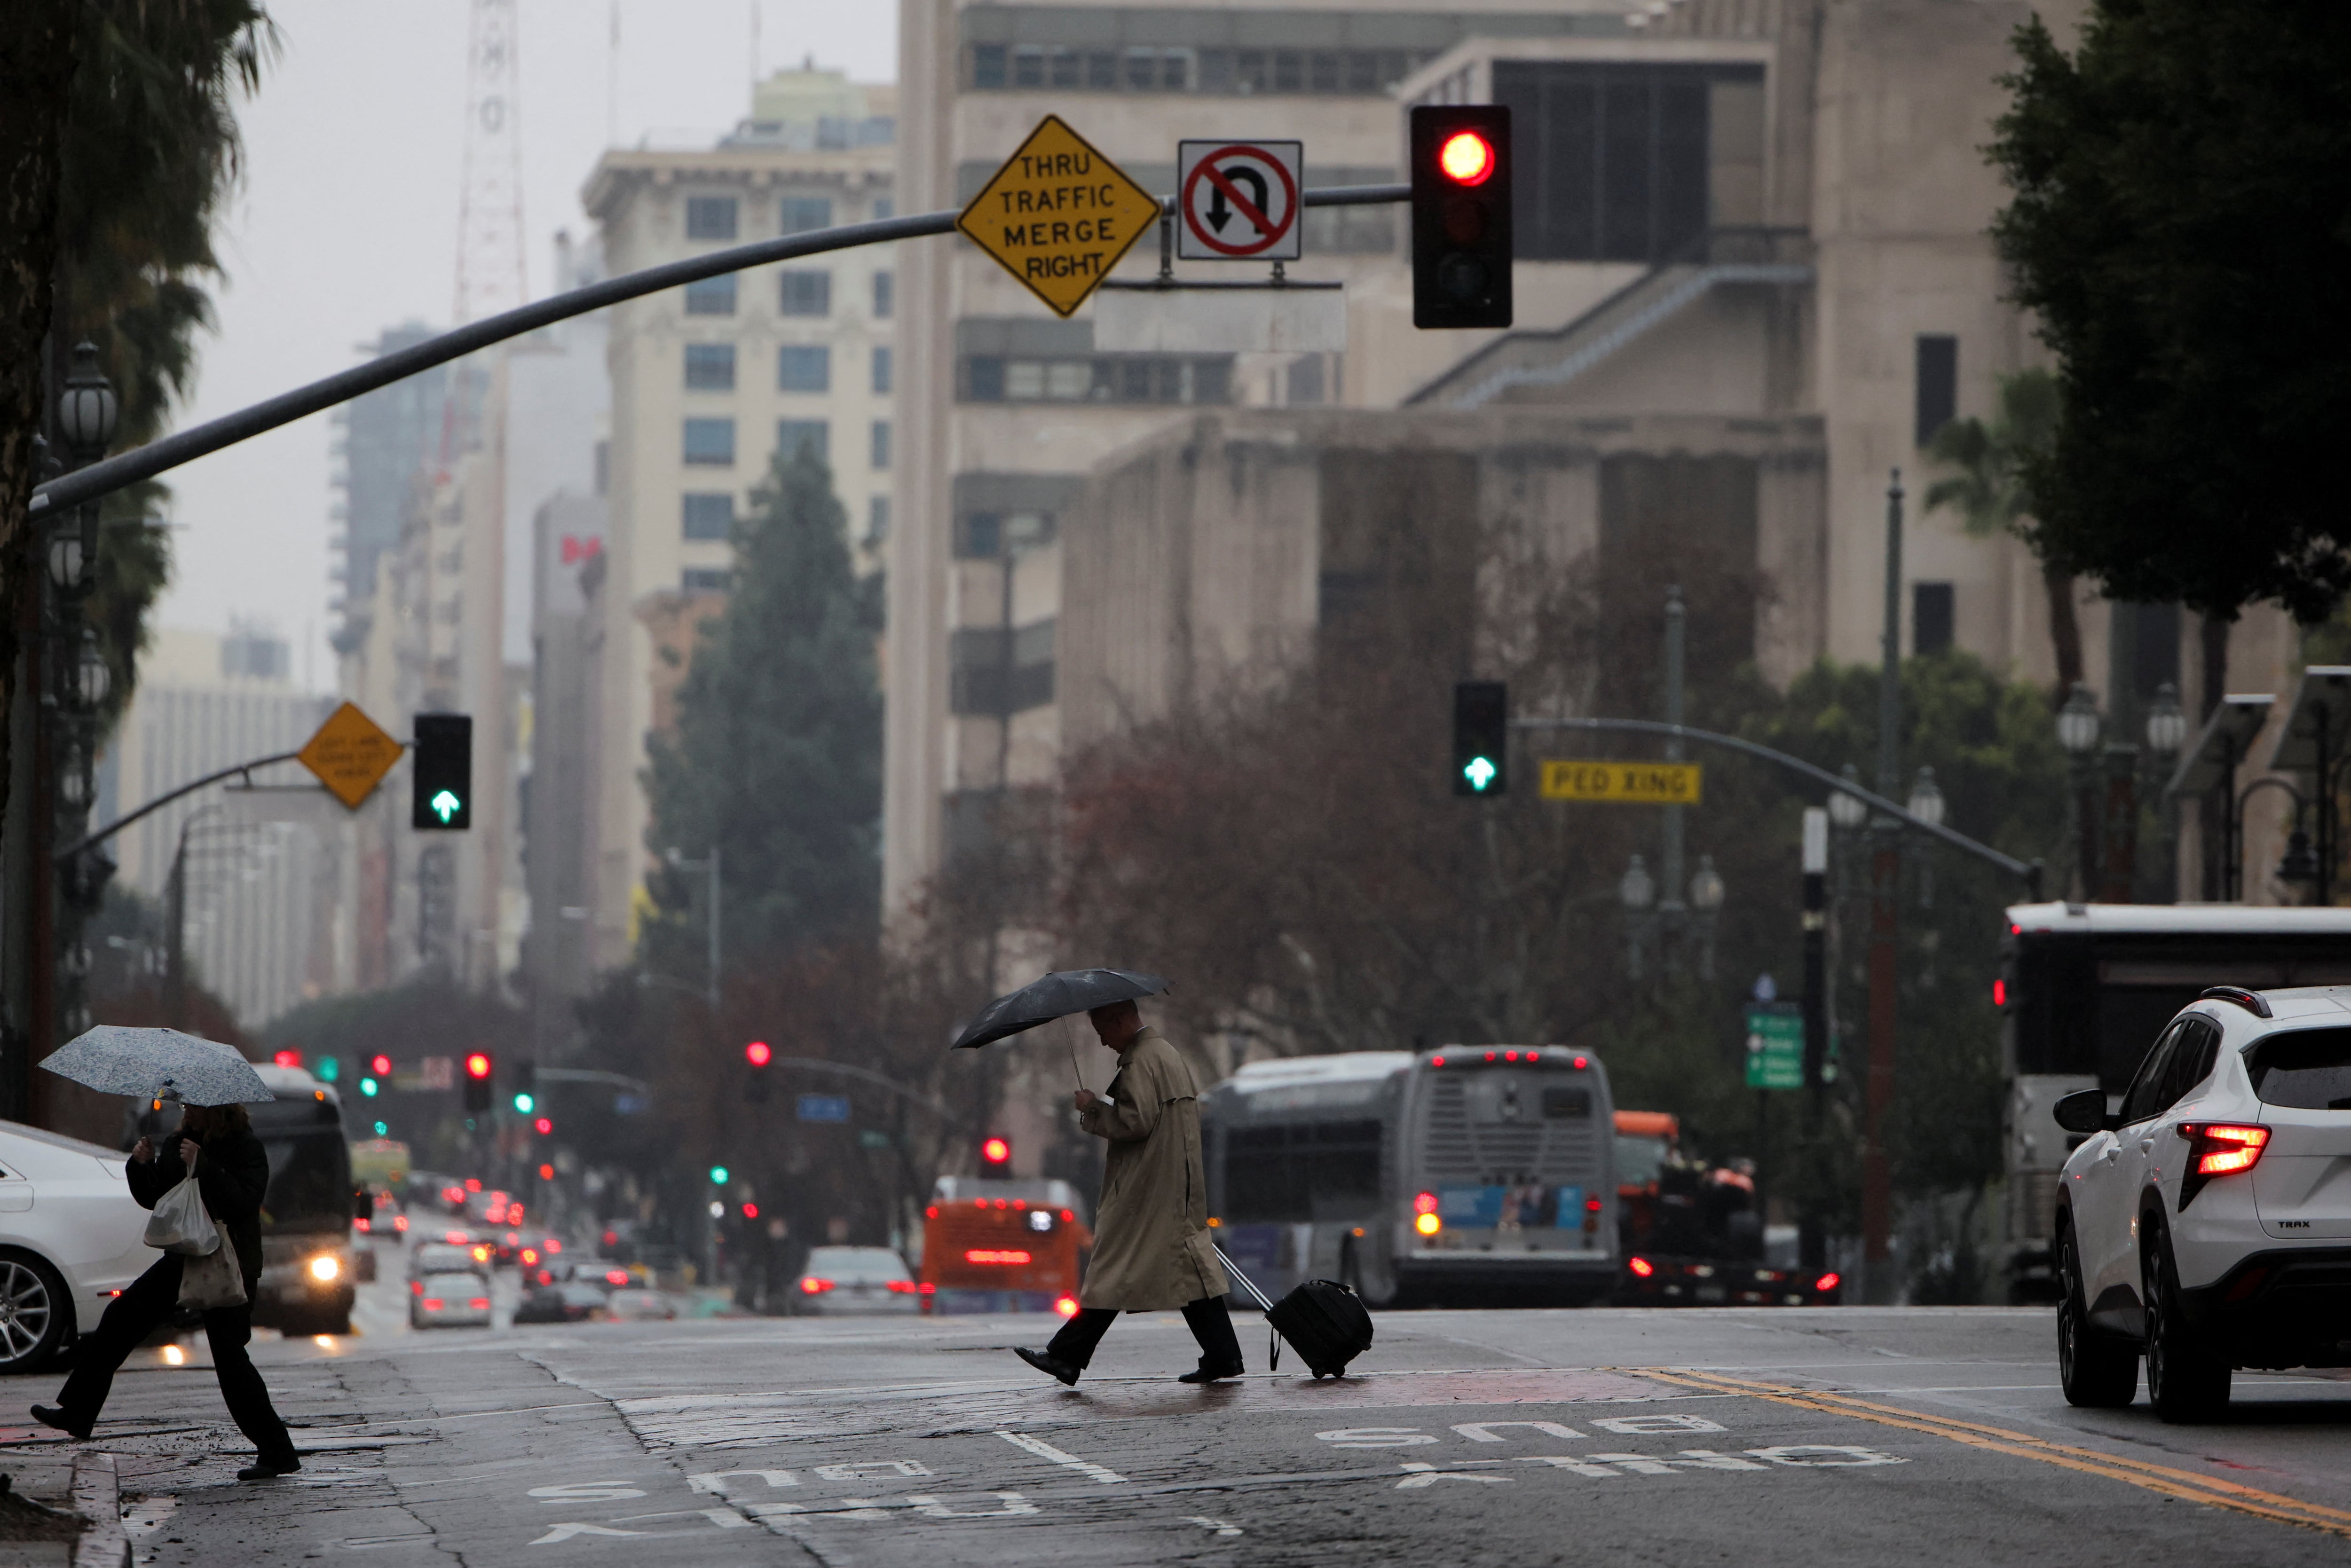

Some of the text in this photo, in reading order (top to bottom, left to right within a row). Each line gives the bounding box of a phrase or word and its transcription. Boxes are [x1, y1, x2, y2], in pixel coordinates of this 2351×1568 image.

[1020, 153, 1091, 179] THRU
[1000, 184, 1114, 213] TRAFFIC
[1004, 218, 1116, 247] MERGE
[1026, 252, 1104, 279] RIGHT
[1554, 766, 1688, 794] PED XING
[1314, 1413, 1729, 1449] BUS
[1394, 1444, 1912, 1489] ONLY
[526, 1459, 938, 1504] BUS
